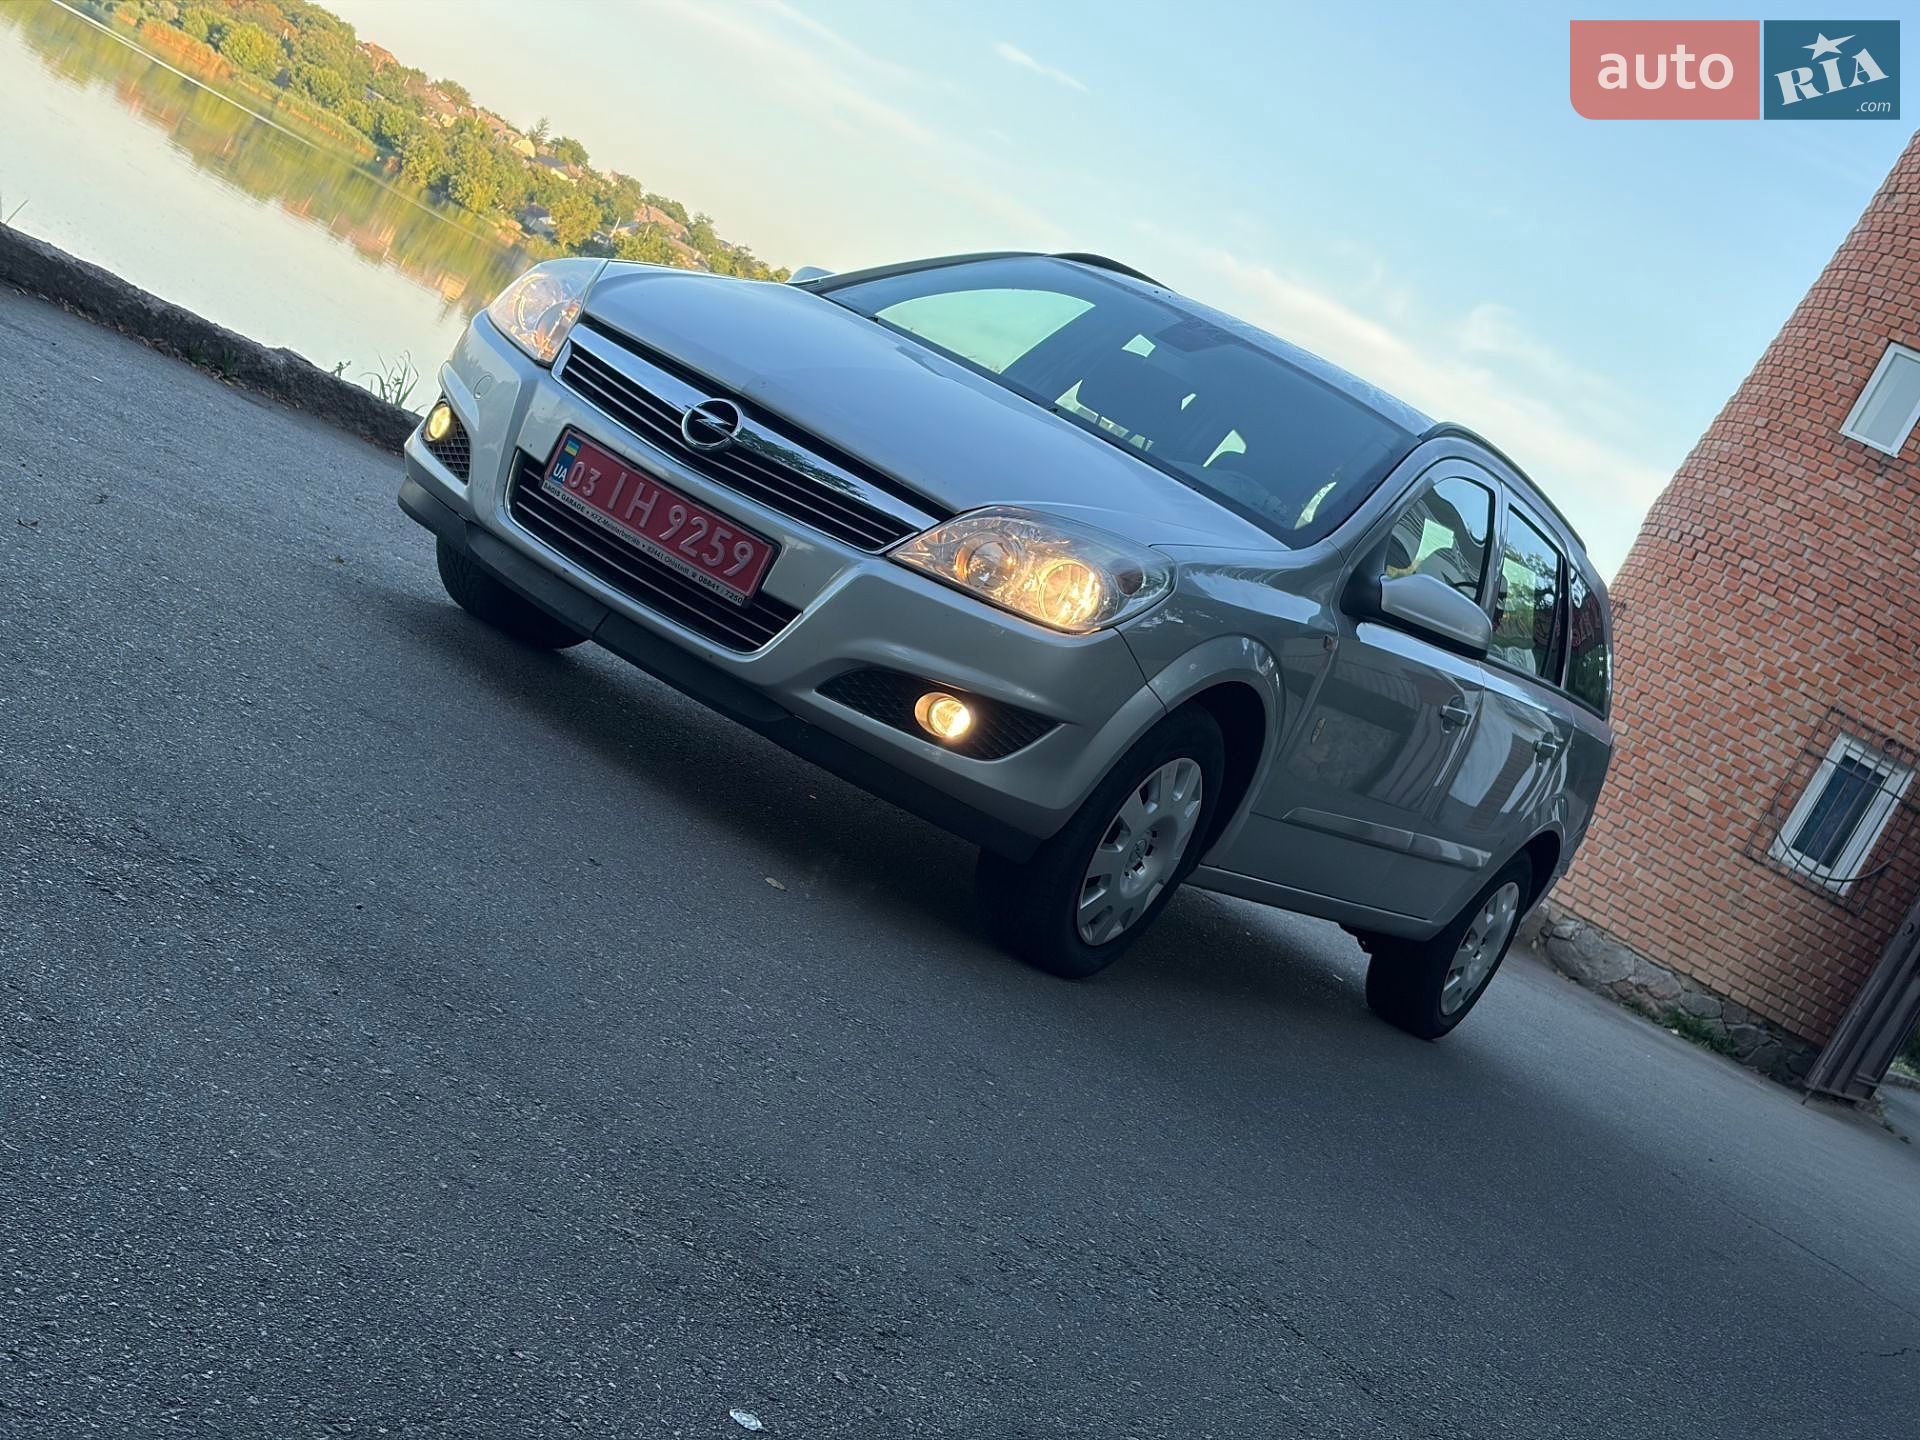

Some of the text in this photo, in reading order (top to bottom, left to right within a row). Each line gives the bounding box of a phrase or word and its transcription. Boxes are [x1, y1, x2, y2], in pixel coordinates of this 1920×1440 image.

[552, 463, 568, 482] UA
[561, 495, 586, 512] GARAGE
[568, 461, 755, 577] 03 IH 9259
